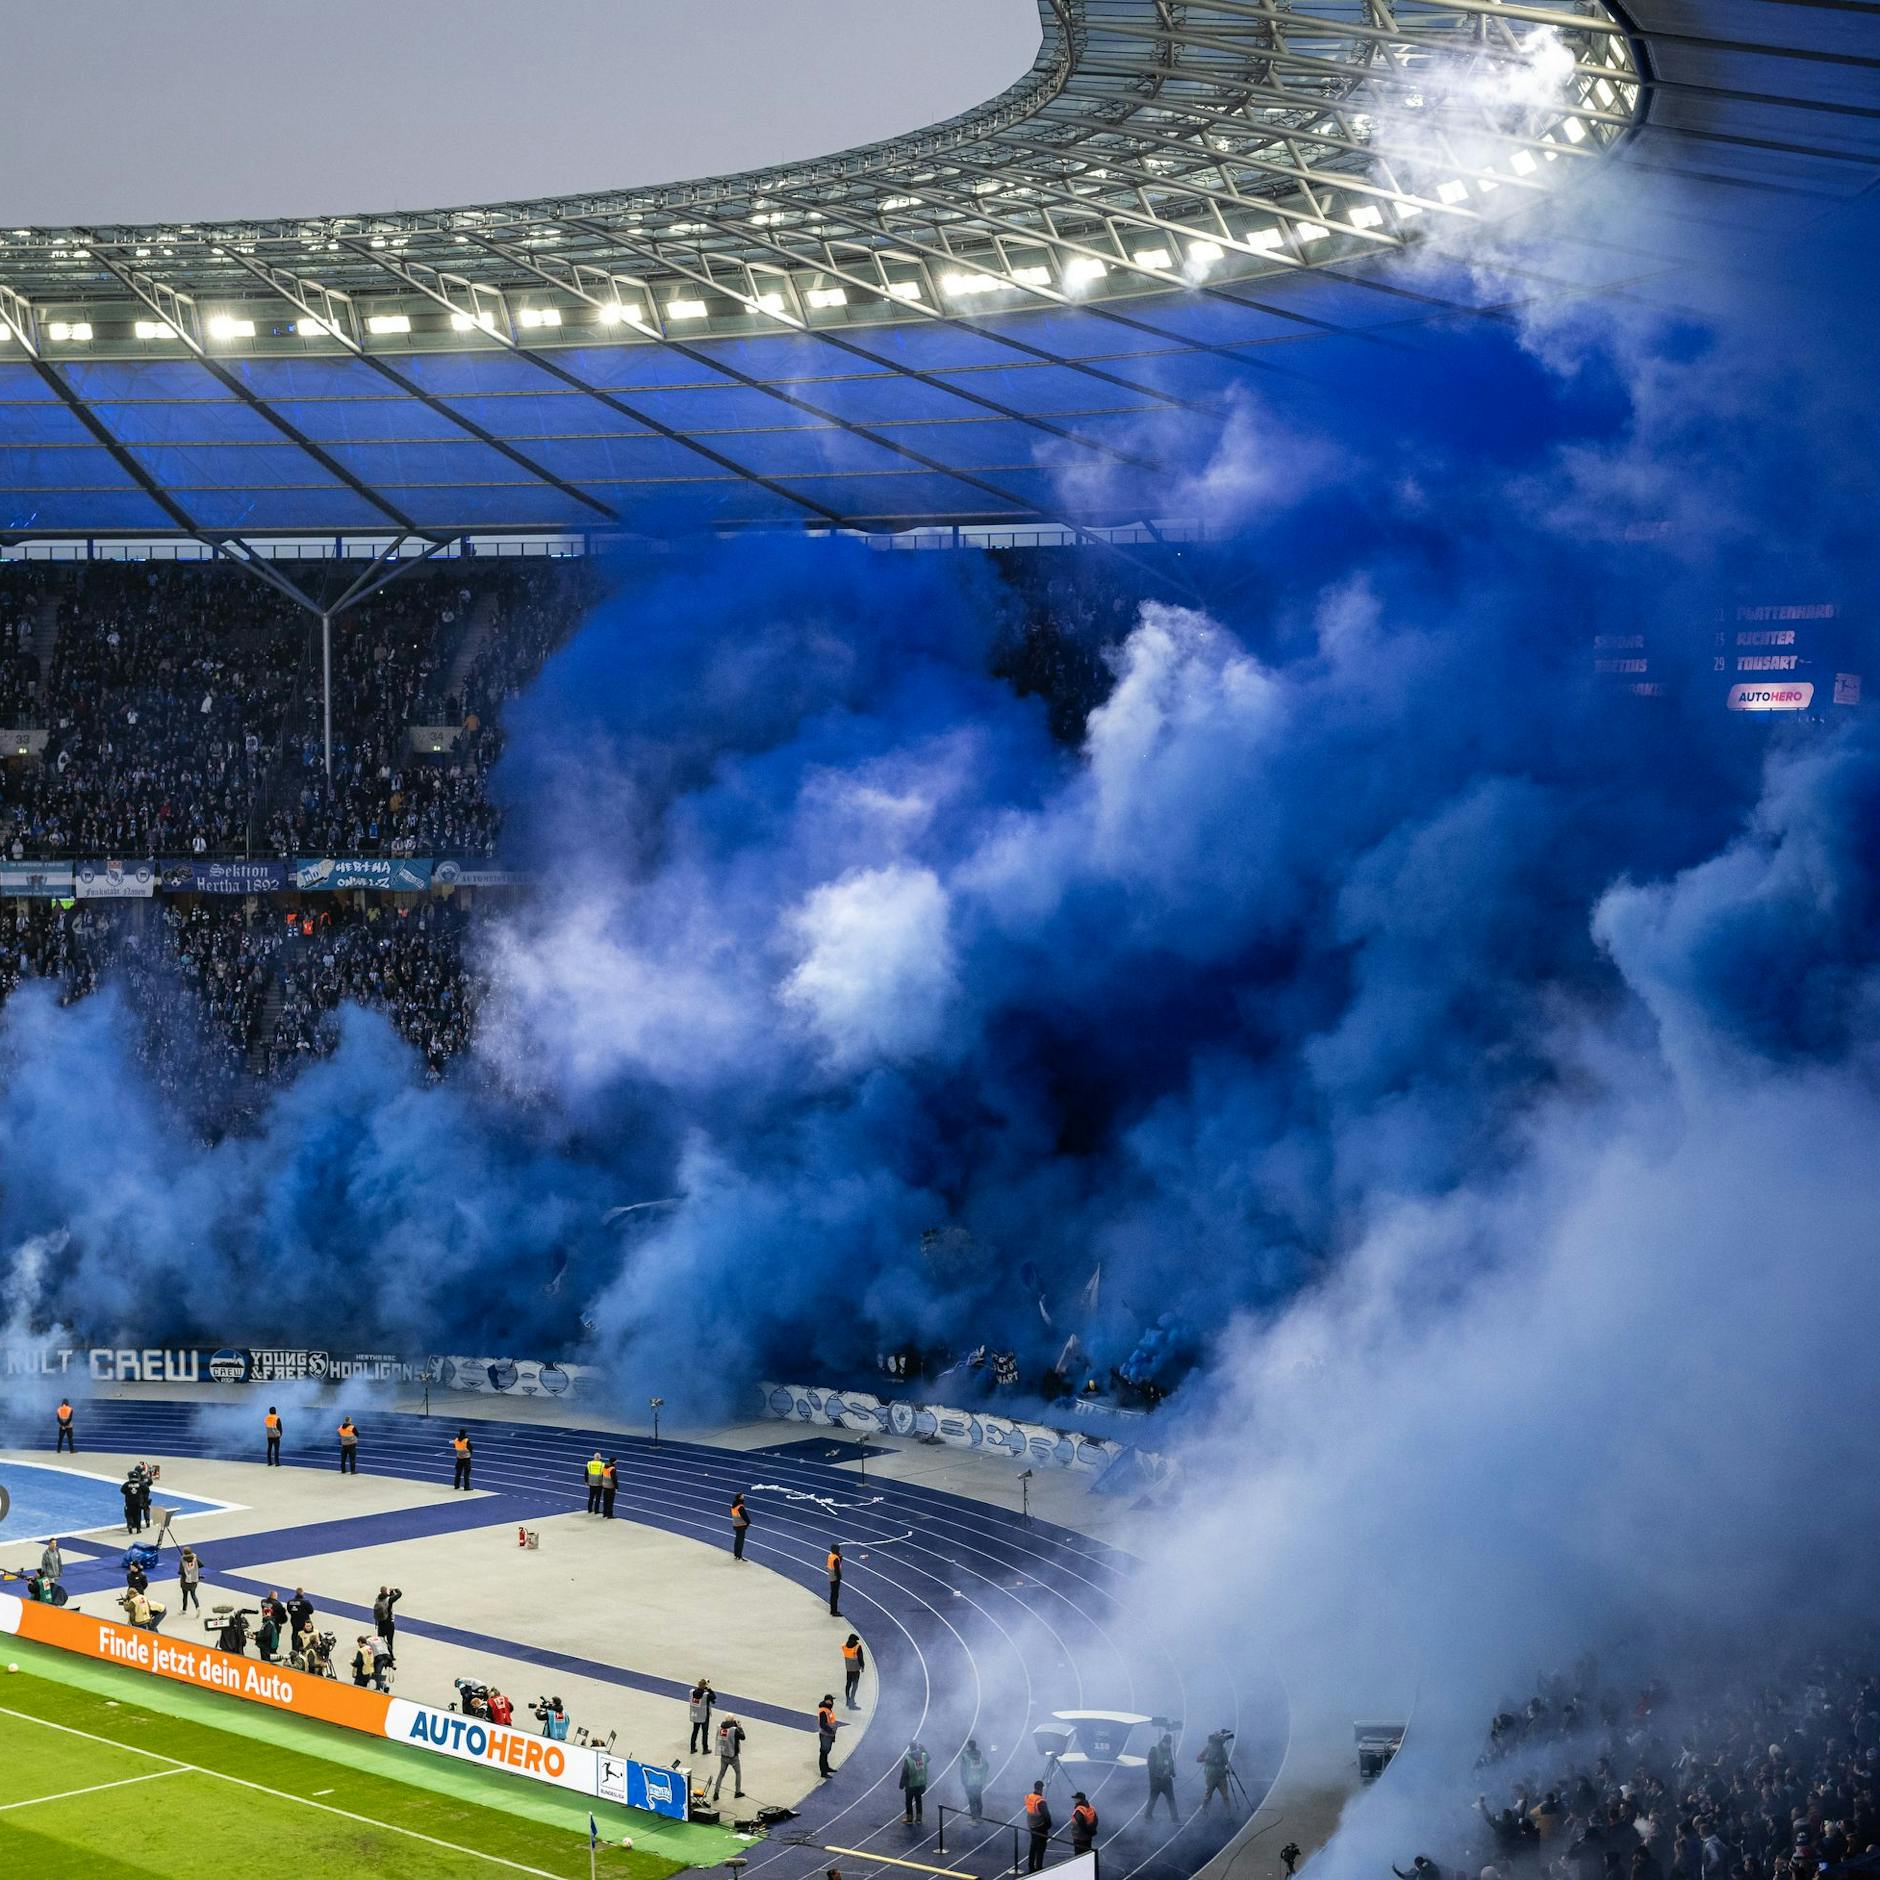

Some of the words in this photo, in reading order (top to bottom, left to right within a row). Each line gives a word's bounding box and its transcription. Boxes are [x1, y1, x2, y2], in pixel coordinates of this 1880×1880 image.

[1737, 656, 1798, 670] TOUSART
[1739, 692, 1803, 702] AUTOHERO
[16, 735, 30, 744] 33
[209, 864, 268, 877] Sektion
[197, 877, 240, 893] Hertha
[247, 880, 280, 892] 1892
[89, 1349, 199, 1381] CREW
[250, 1352, 307, 1366] YOUNG
[213, 1368, 242, 1378] CREW
[99, 1626, 149, 1664] Finde
[151, 1640, 195, 1677] jetzt
[199, 1653, 240, 1690] dein
[244, 1666, 294, 1703] Auto
[409, 1711, 565, 1777] AUTOHERO
